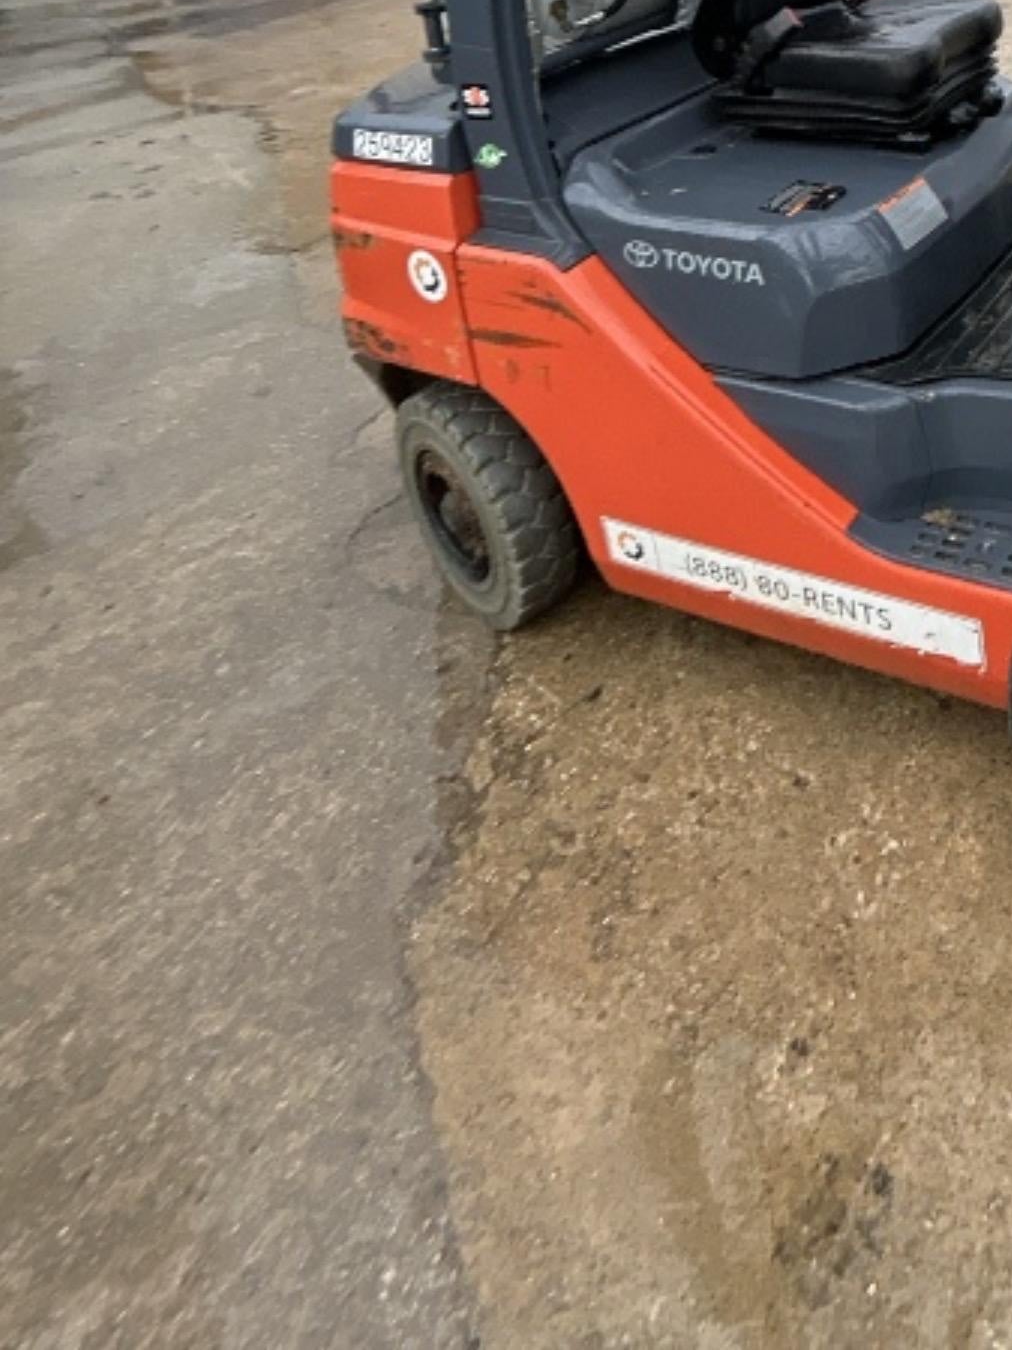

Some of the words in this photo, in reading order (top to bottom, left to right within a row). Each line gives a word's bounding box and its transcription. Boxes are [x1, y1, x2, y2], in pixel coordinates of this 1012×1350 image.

[662, 248, 766, 286] TOYOTA
[684, 553, 748, 591] (888)
[755, 574, 893, 631] 80-RENTS
